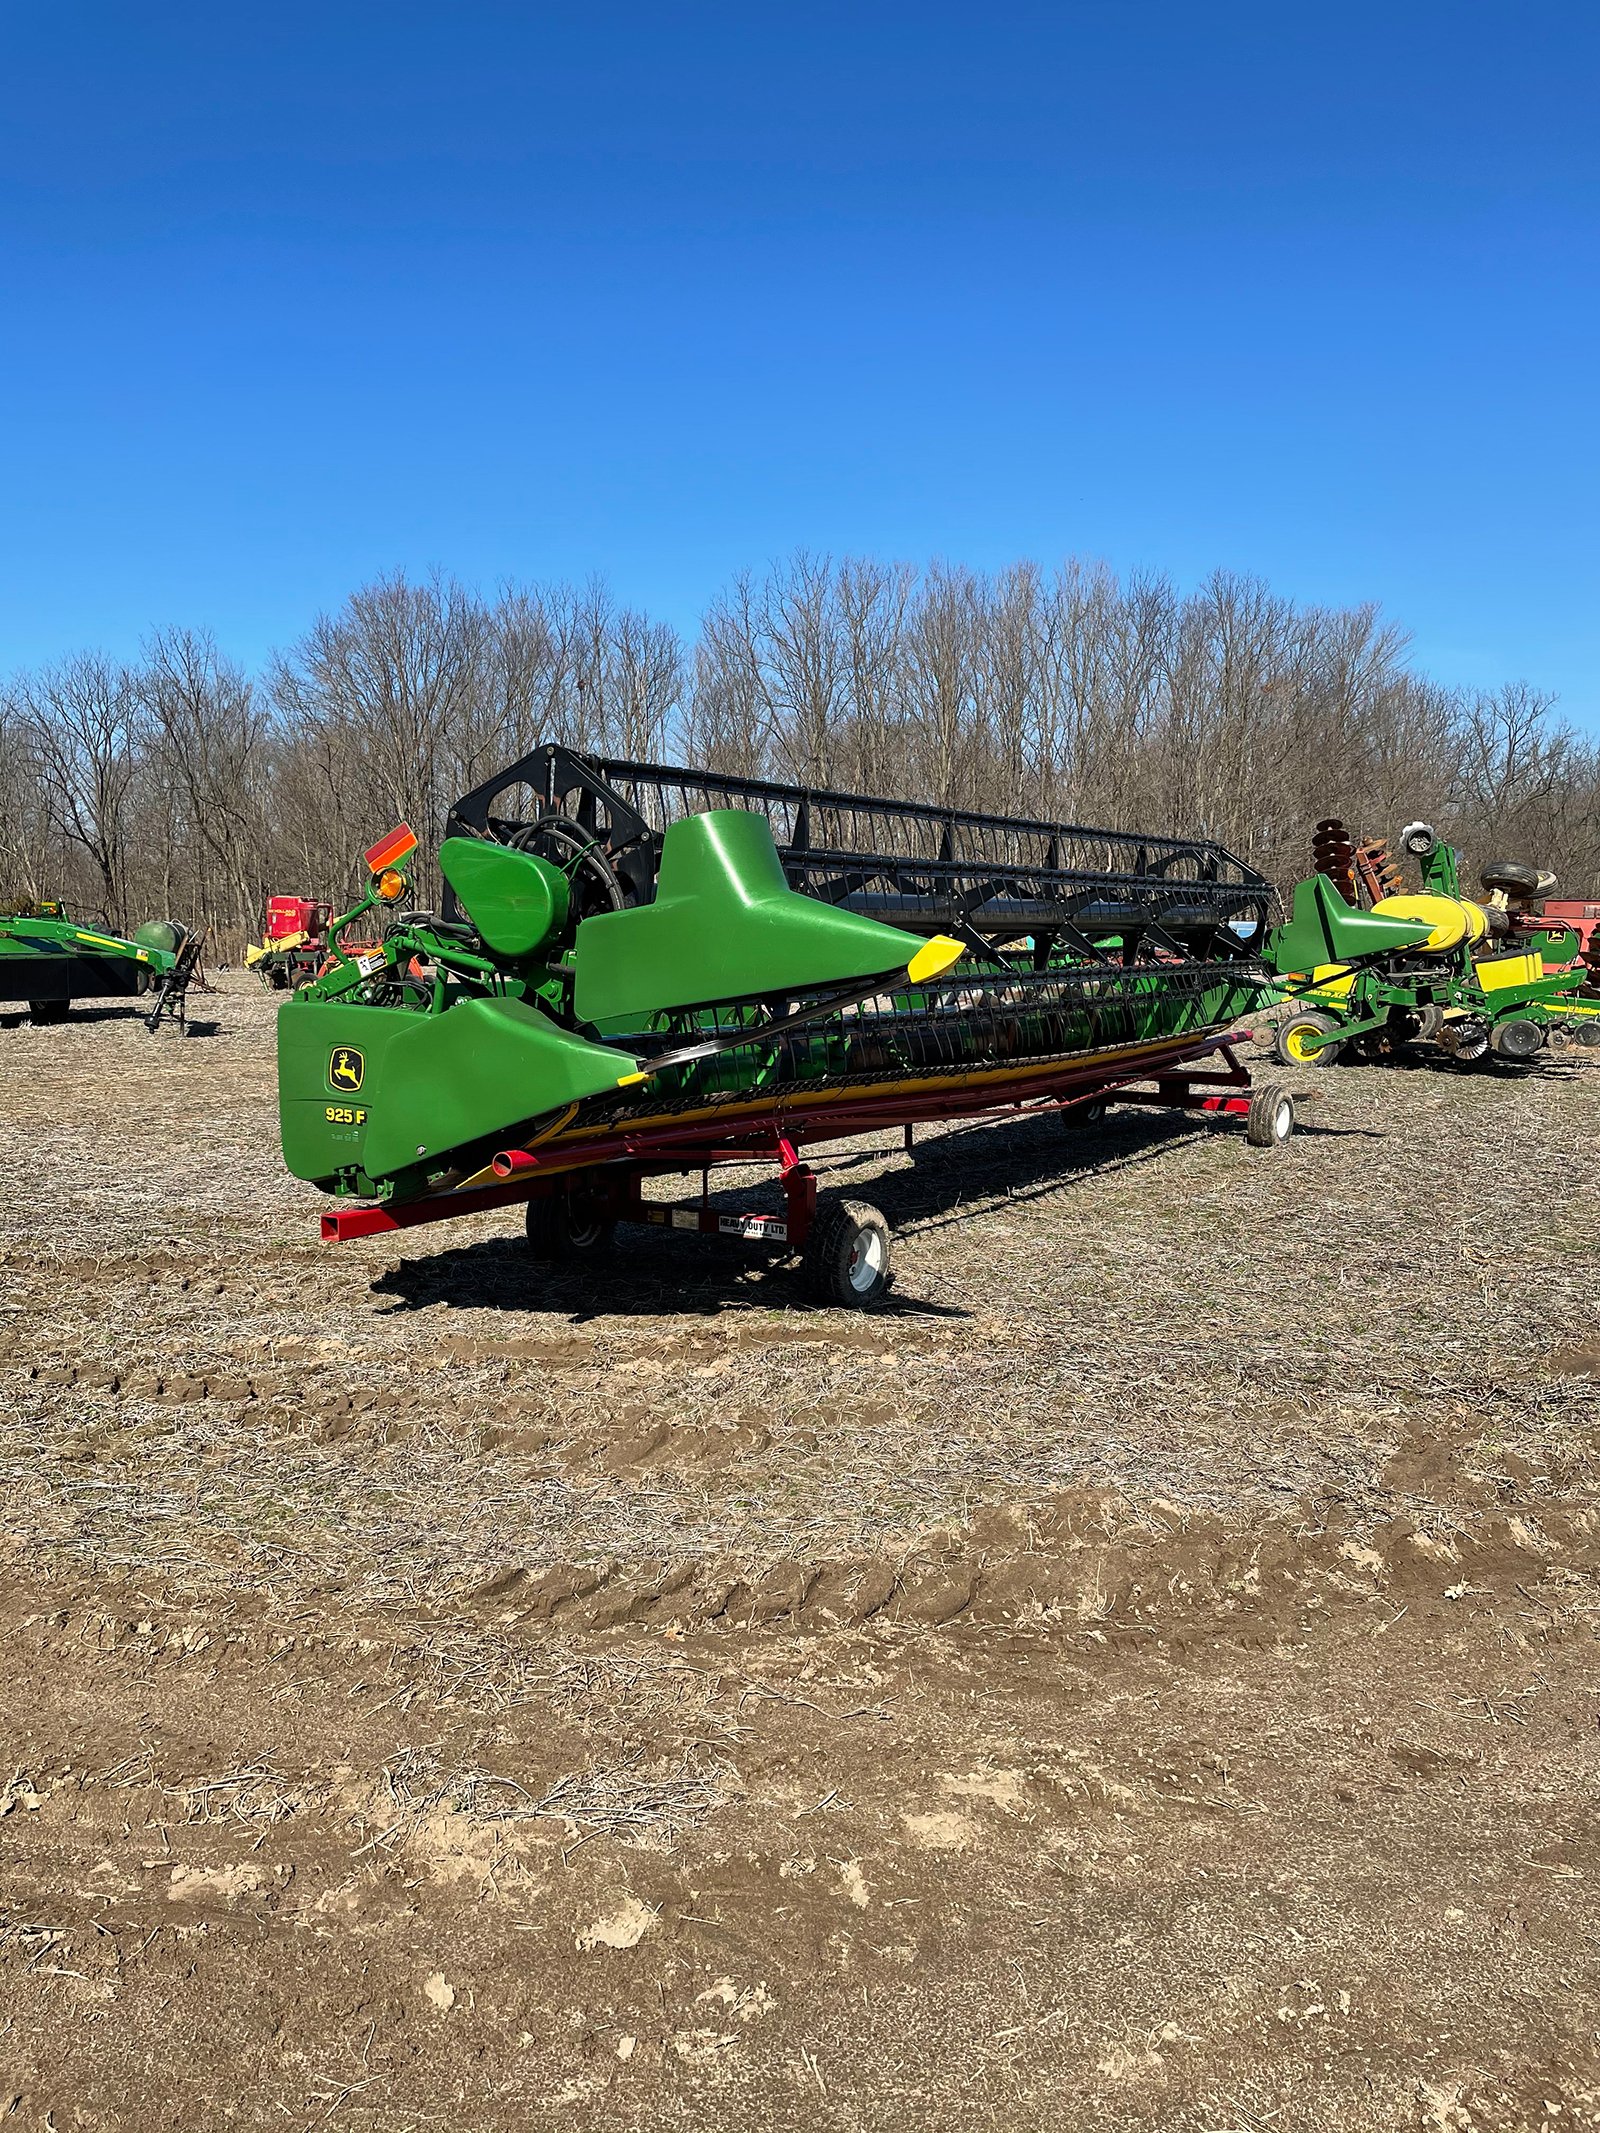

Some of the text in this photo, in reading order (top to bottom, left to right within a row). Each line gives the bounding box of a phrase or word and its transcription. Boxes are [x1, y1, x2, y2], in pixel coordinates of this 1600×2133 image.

[325, 1107, 366, 1125] 925 F
[720, 1217, 745, 1230] HEAVY
[748, 1221, 769, 1232] DUTY
[771, 1224, 786, 1235] LTD.
